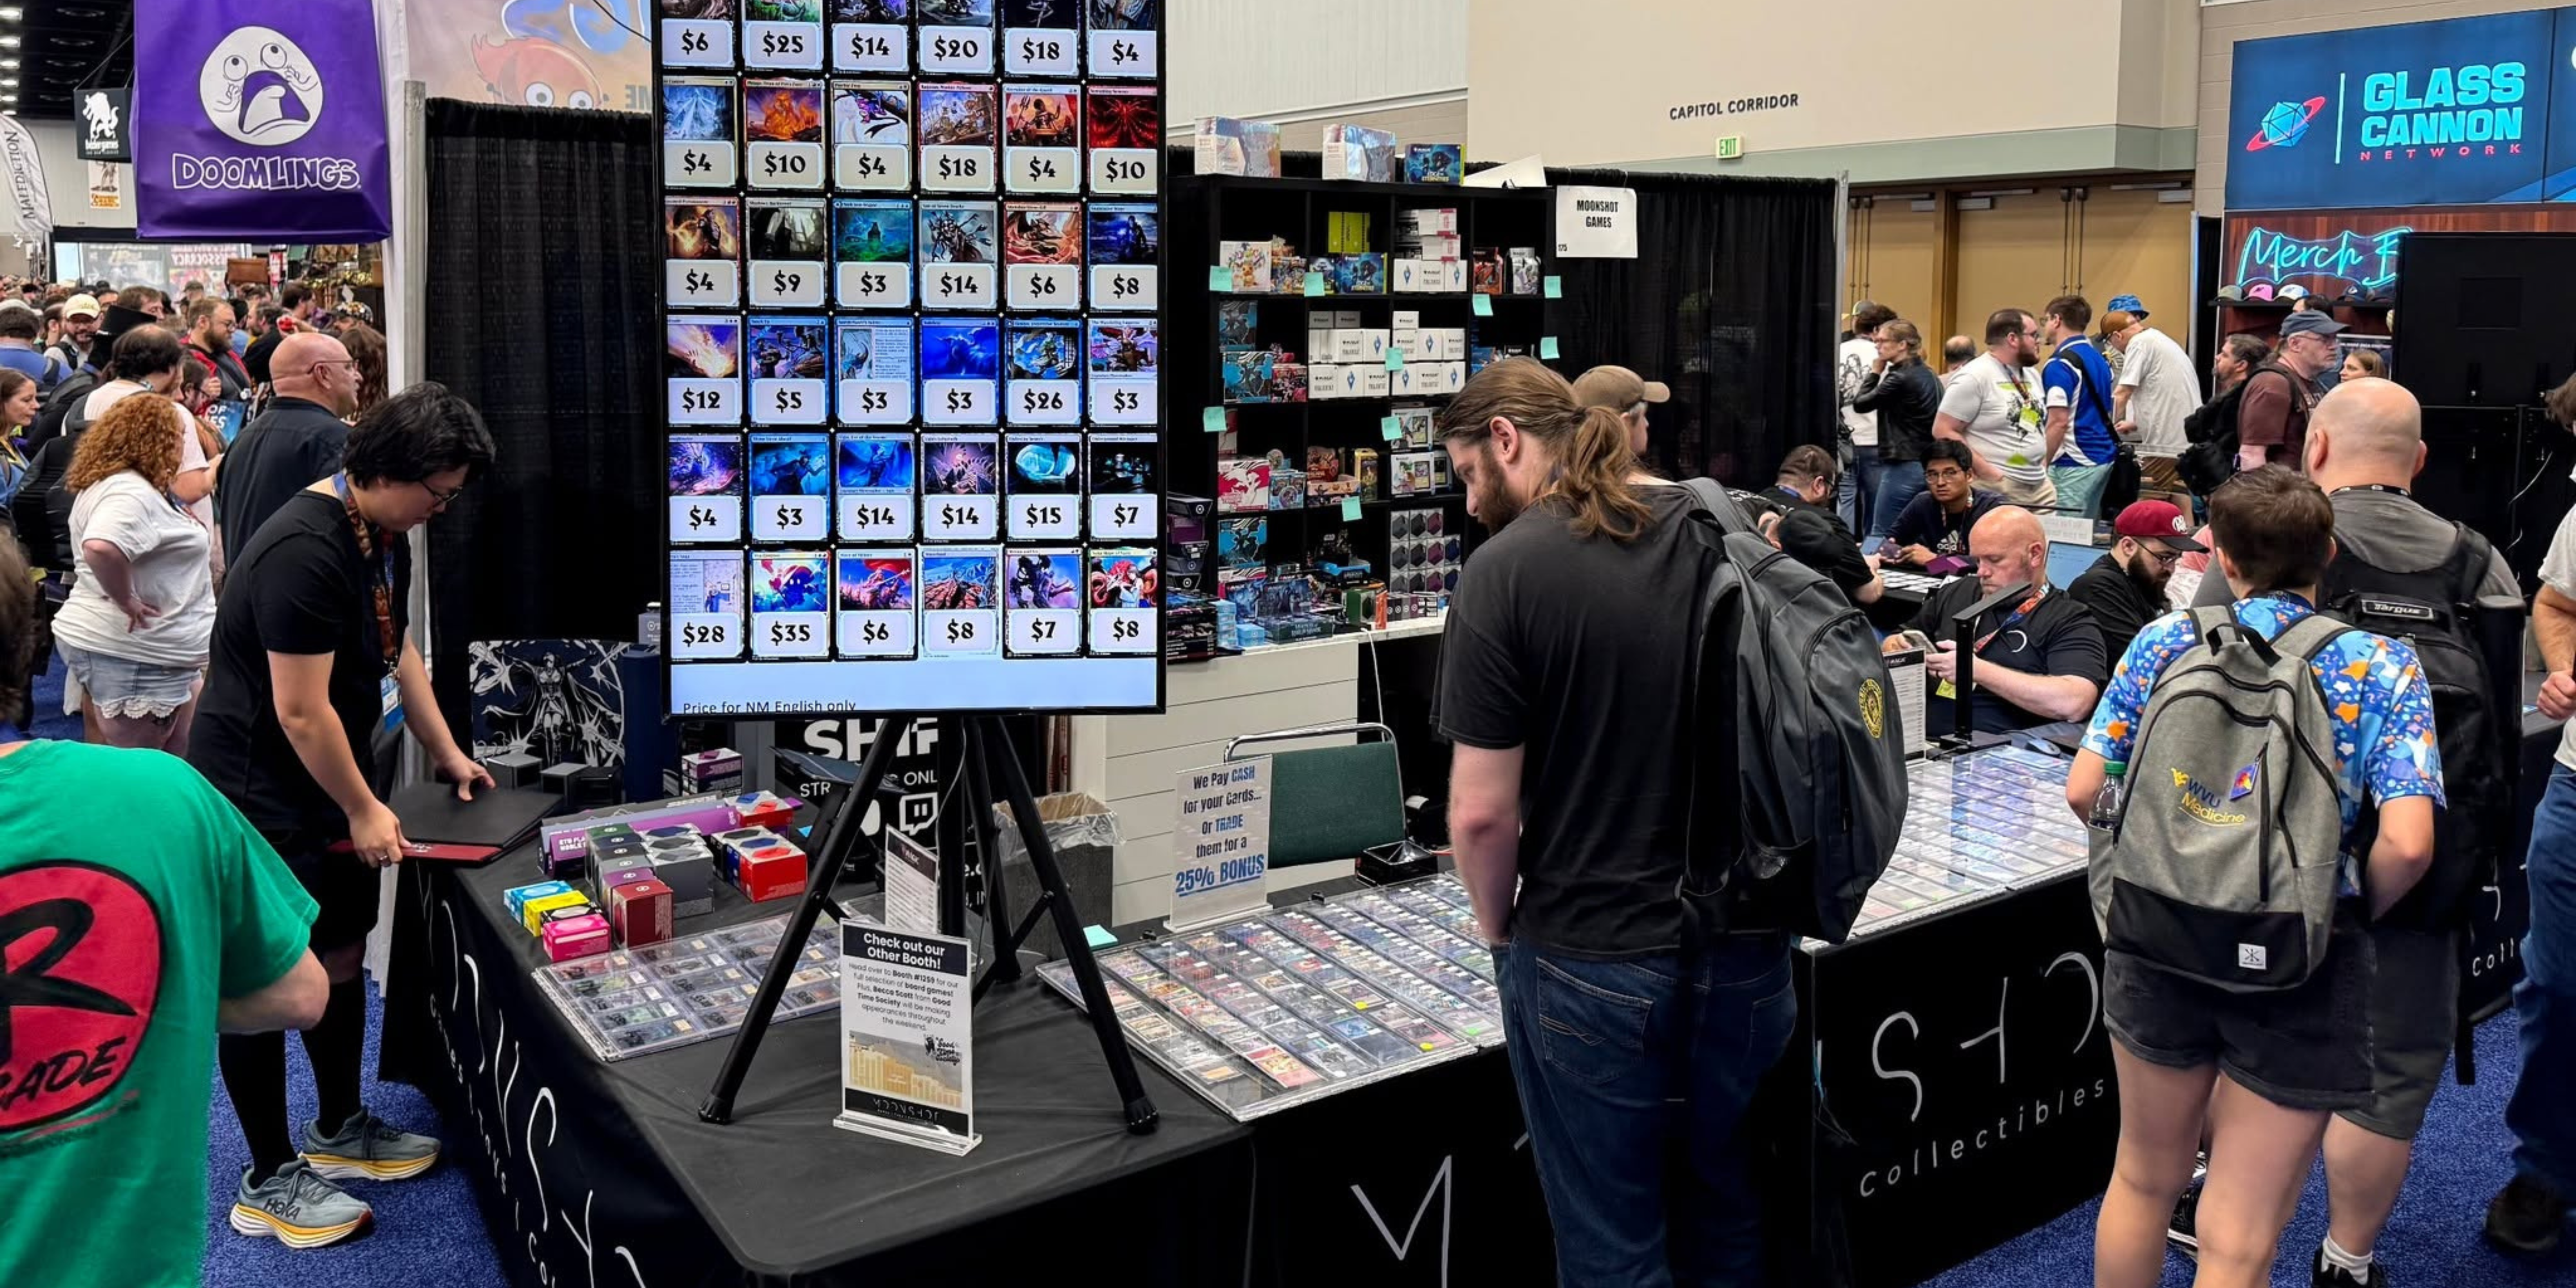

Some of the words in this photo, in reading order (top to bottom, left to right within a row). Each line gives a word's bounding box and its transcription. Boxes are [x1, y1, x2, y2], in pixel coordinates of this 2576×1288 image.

[682, 29, 708, 55] $6
[763, 31, 803, 57] $25
[852, 34, 889, 59] $14
[935, 35, 978, 61] $20
[1023, 38, 1059, 63] $18
[1112, 40, 1138, 65] $4
[2363, 62, 2525, 112] GLASS
[1670, 102, 1723, 120] CAPITOL
[1728, 93, 1798, 113] CORRIDOR
[2360, 107, 2523, 148] CANNON
[1720, 138, 1737, 156] EXIT
[2360, 143, 2522, 161] NETWORK
[172, 153, 360, 191] DOOMLINGS
[684, 149, 712, 175] $4
[765, 151, 805, 177] $10
[859, 153, 886, 178] $4
[939, 155, 976, 179] $18
[1030, 157, 1055, 182] $4
[1106, 158, 1144, 182] $10
[1577, 200, 1618, 212] MOONSHOT
[1585, 216, 1612, 228] GAMES
[2238, 229, 2363, 284] Merch
[686, 269, 713, 294] $4
[774, 270, 800, 295] $9
[861, 271, 886, 296] $3
[941, 272, 978, 297] $14
[1030, 273, 1055, 298] $6
[1114, 274, 1139, 299] $8
[683, 388, 720, 413] $12
[776, 388, 801, 413] $5
[863, 388, 887, 413] $3
[948, 389, 971, 413] $3
[1024, 389, 1063, 413] $26
[1114, 389, 1137, 413] $3
[690, 505, 716, 530] $4
[777, 505, 802, 529] $3
[858, 504, 894, 529] $14
[942, 504, 979, 528] $14
[1026, 504, 1060, 528] $15
[1114, 504, 1138, 527] $7
[2374, 603, 2422, 614] Targus
[683, 623, 724, 647] $28
[771, 621, 810, 646] $35
[864, 620, 888, 644] $6
[948, 619, 973, 643] $8
[1032, 618, 1055, 642] $7
[1114, 617, 1138, 641] $8
[683, 701, 716, 714] Price
[721, 701, 741, 713] for
[746, 701, 770, 713] NM
[775, 700, 823, 712] English
[827, 699, 856, 712] only
[1193, 775, 1208, 789] We
[1211, 772, 1229, 786] Pay
[1232, 766, 1255, 782] CASH
[1184, 799, 1197, 814] for
[1200, 795, 1224, 812] your
[2188, 778, 2220, 807] WVU
[2182, 792, 2246, 822] Medicine
[1216, 814, 1243, 833] TRADE
[1196, 841, 1221, 858] them
[1224, 837, 1238, 852] for
[1241, 836, 1247, 849] a
[1175, 866, 1215, 893] 25%
[1220, 854, 1265, 883] BONUS
[864, 932, 900, 949] Check
[902, 940, 923, 953] out
[924, 944, 945, 957] our
[868, 947, 901, 962] Other
[902, 952, 941, 969] Booth!
[865, 974, 895, 987] selection
[897, 979, 904, 987] of
[905, 981, 925, 992] board
[927, 986, 953, 997] games!
[868, 966, 882, 974] over
[893, 970, 913, 980] Booth
[936, 978, 945, 986] for
[857, 992, 874, 1001] Time
[875, 995, 901, 1007] Society
[914, 1003, 924, 1011] be
[924, 1005, 950, 1018] making
[873, 985, 894, 996] Becca
[895, 989, 914, 1000] Scott
[915, 993, 931, 1001] from
[932, 996, 951, 1006] Good
[861, 1004, 907, 1017] appearances
[908, 1010, 946, 1025] throughout
[882, 1016, 894, 1025] the
[1860, 1077, 2105, 1197] Collectibles
[264, 1199, 301, 1221] HOKA
